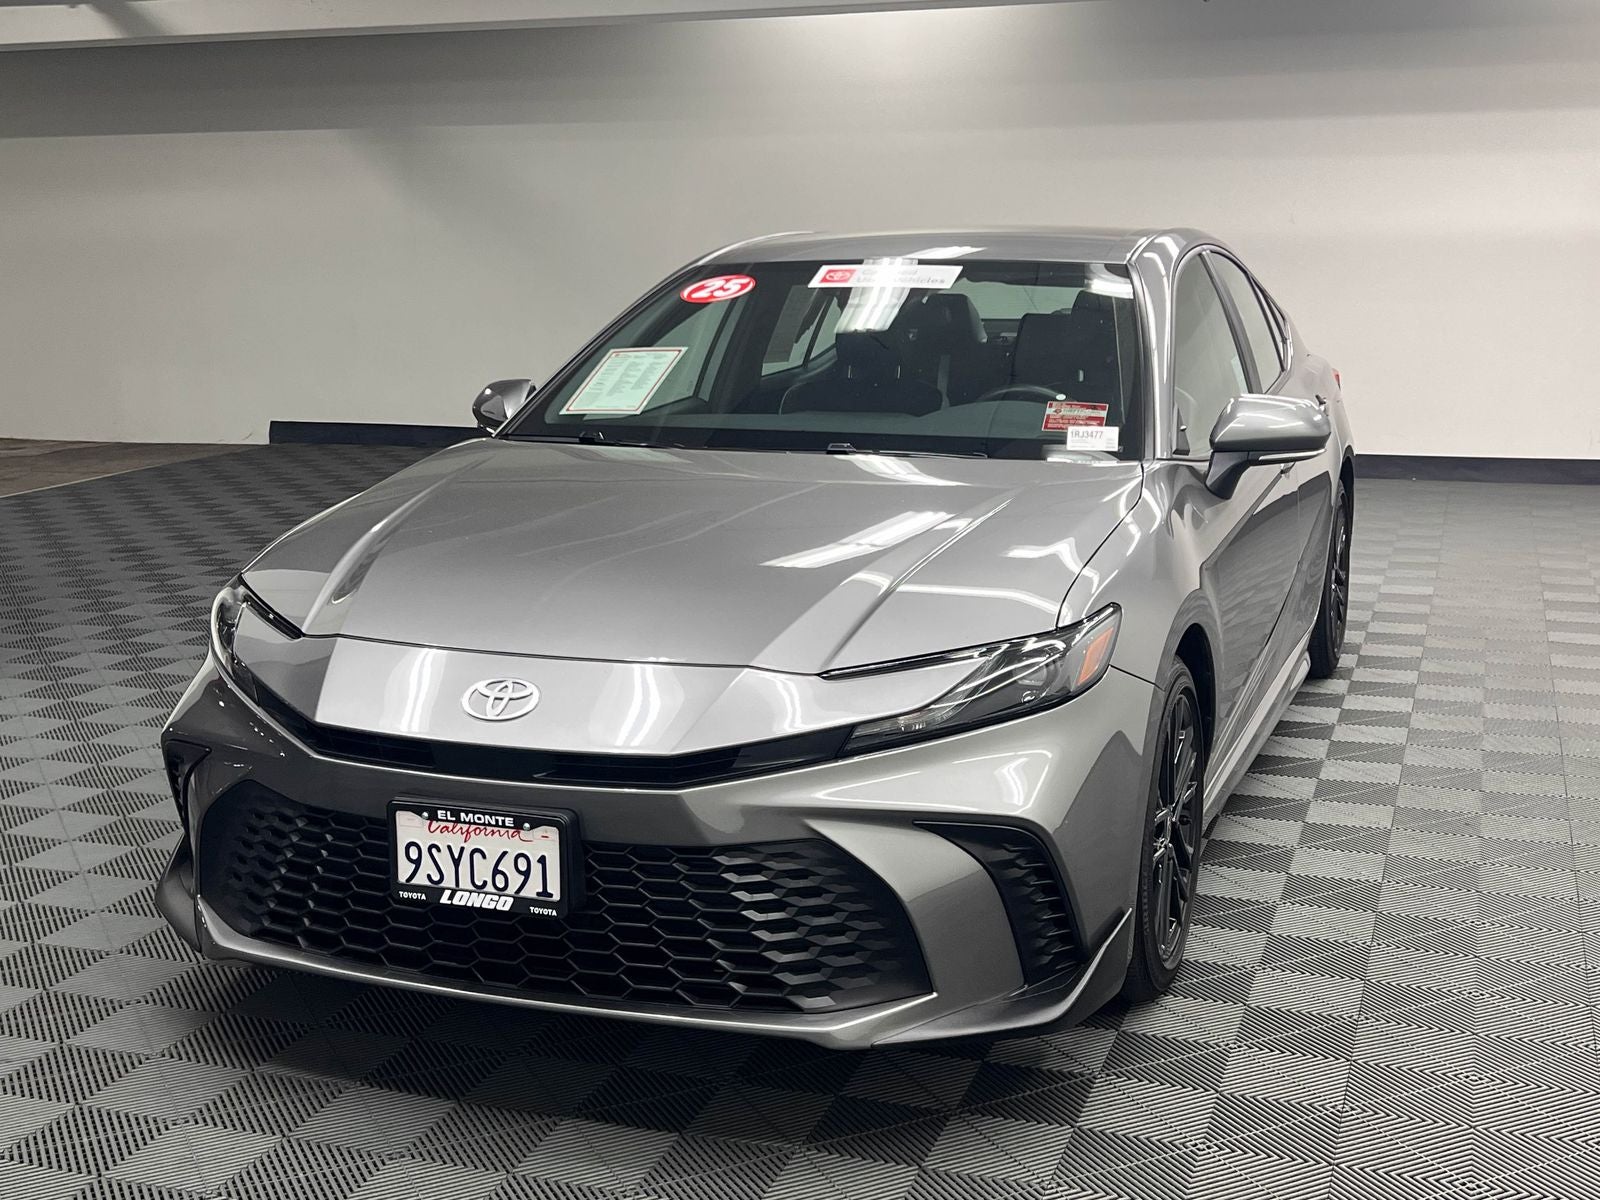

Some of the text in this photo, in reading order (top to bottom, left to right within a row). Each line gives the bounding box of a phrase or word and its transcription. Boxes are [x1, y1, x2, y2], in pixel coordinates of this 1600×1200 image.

[690, 279, 751, 299] 25
[1070, 430, 1104, 440] 1RJ3477
[437, 810, 515, 827] EL MONTE
[427, 820, 534, 843] California
[404, 841, 554, 898] 9SYC691
[398, 890, 427, 901] TOYOTA
[439, 889, 515, 911] LONGO
[529, 906, 557, 917] TOYOTA
